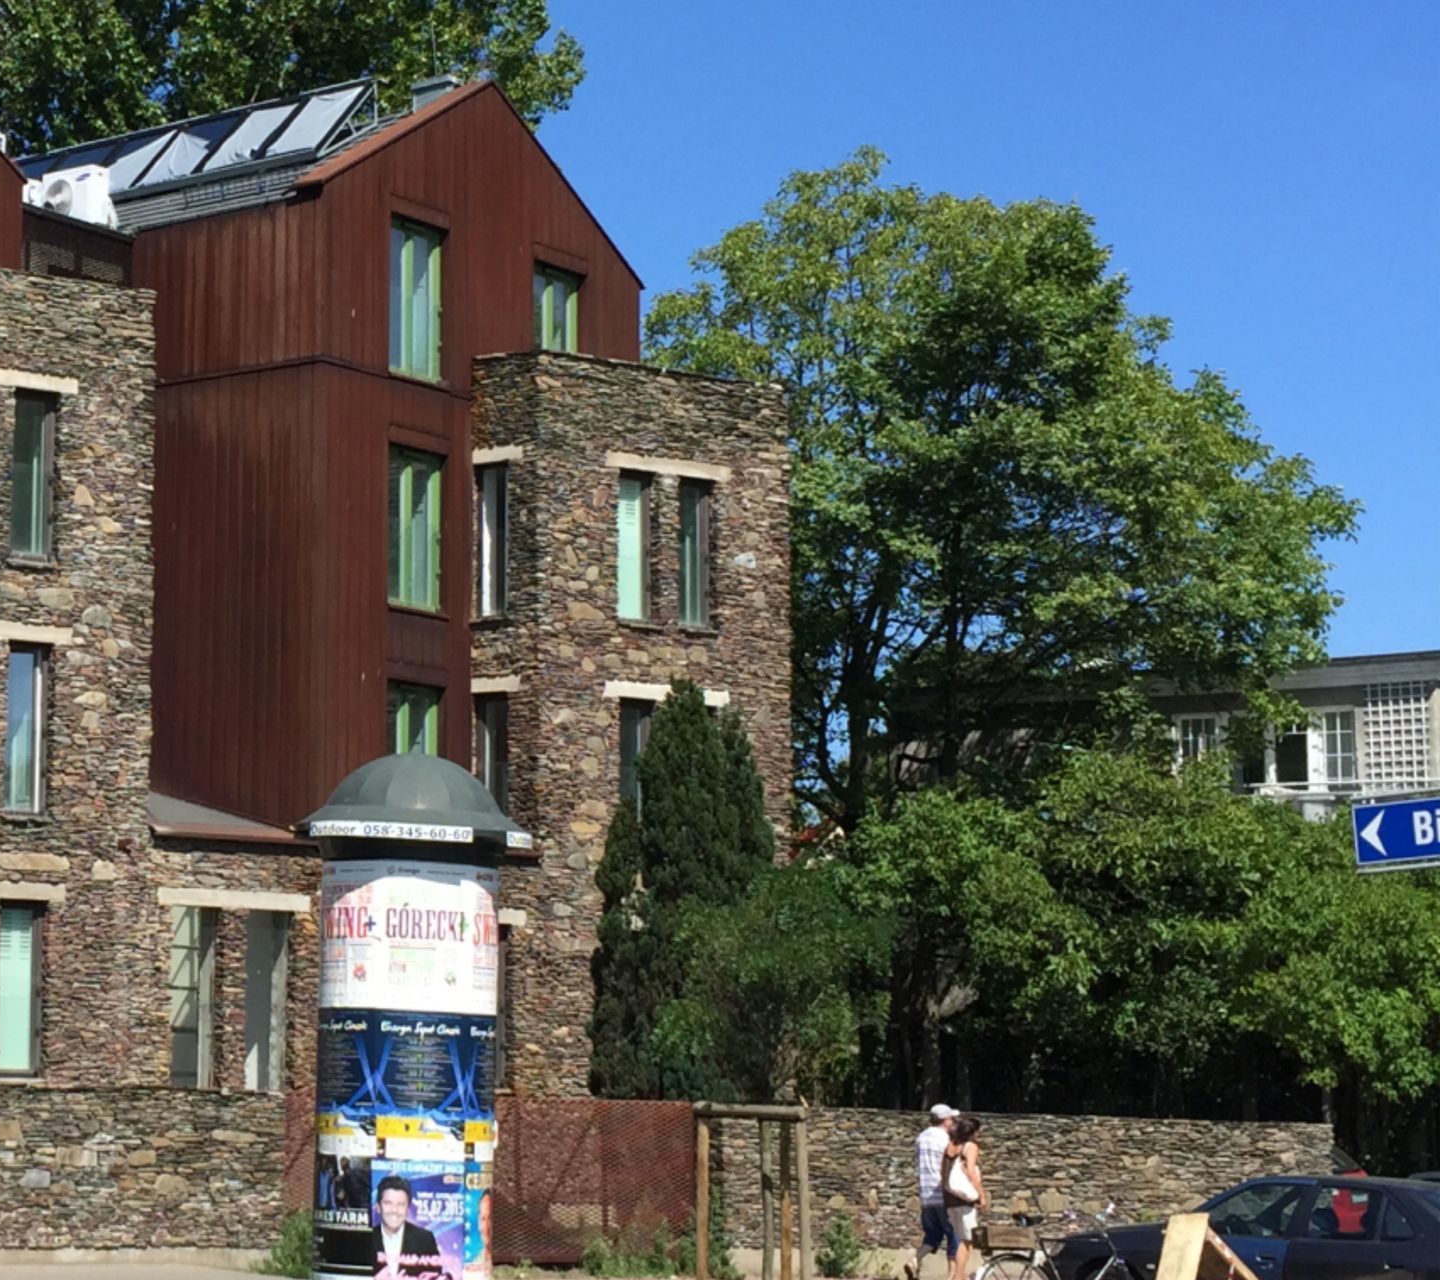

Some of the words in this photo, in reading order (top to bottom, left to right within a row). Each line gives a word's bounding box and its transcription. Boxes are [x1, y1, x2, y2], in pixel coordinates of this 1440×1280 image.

[310, 821, 356, 835] Outdoor
[363, 823, 470, 841] 058-345-60-60
[386, 902, 466, 942] GÓRECKI
[336, 1210, 369, 1225] FARM
